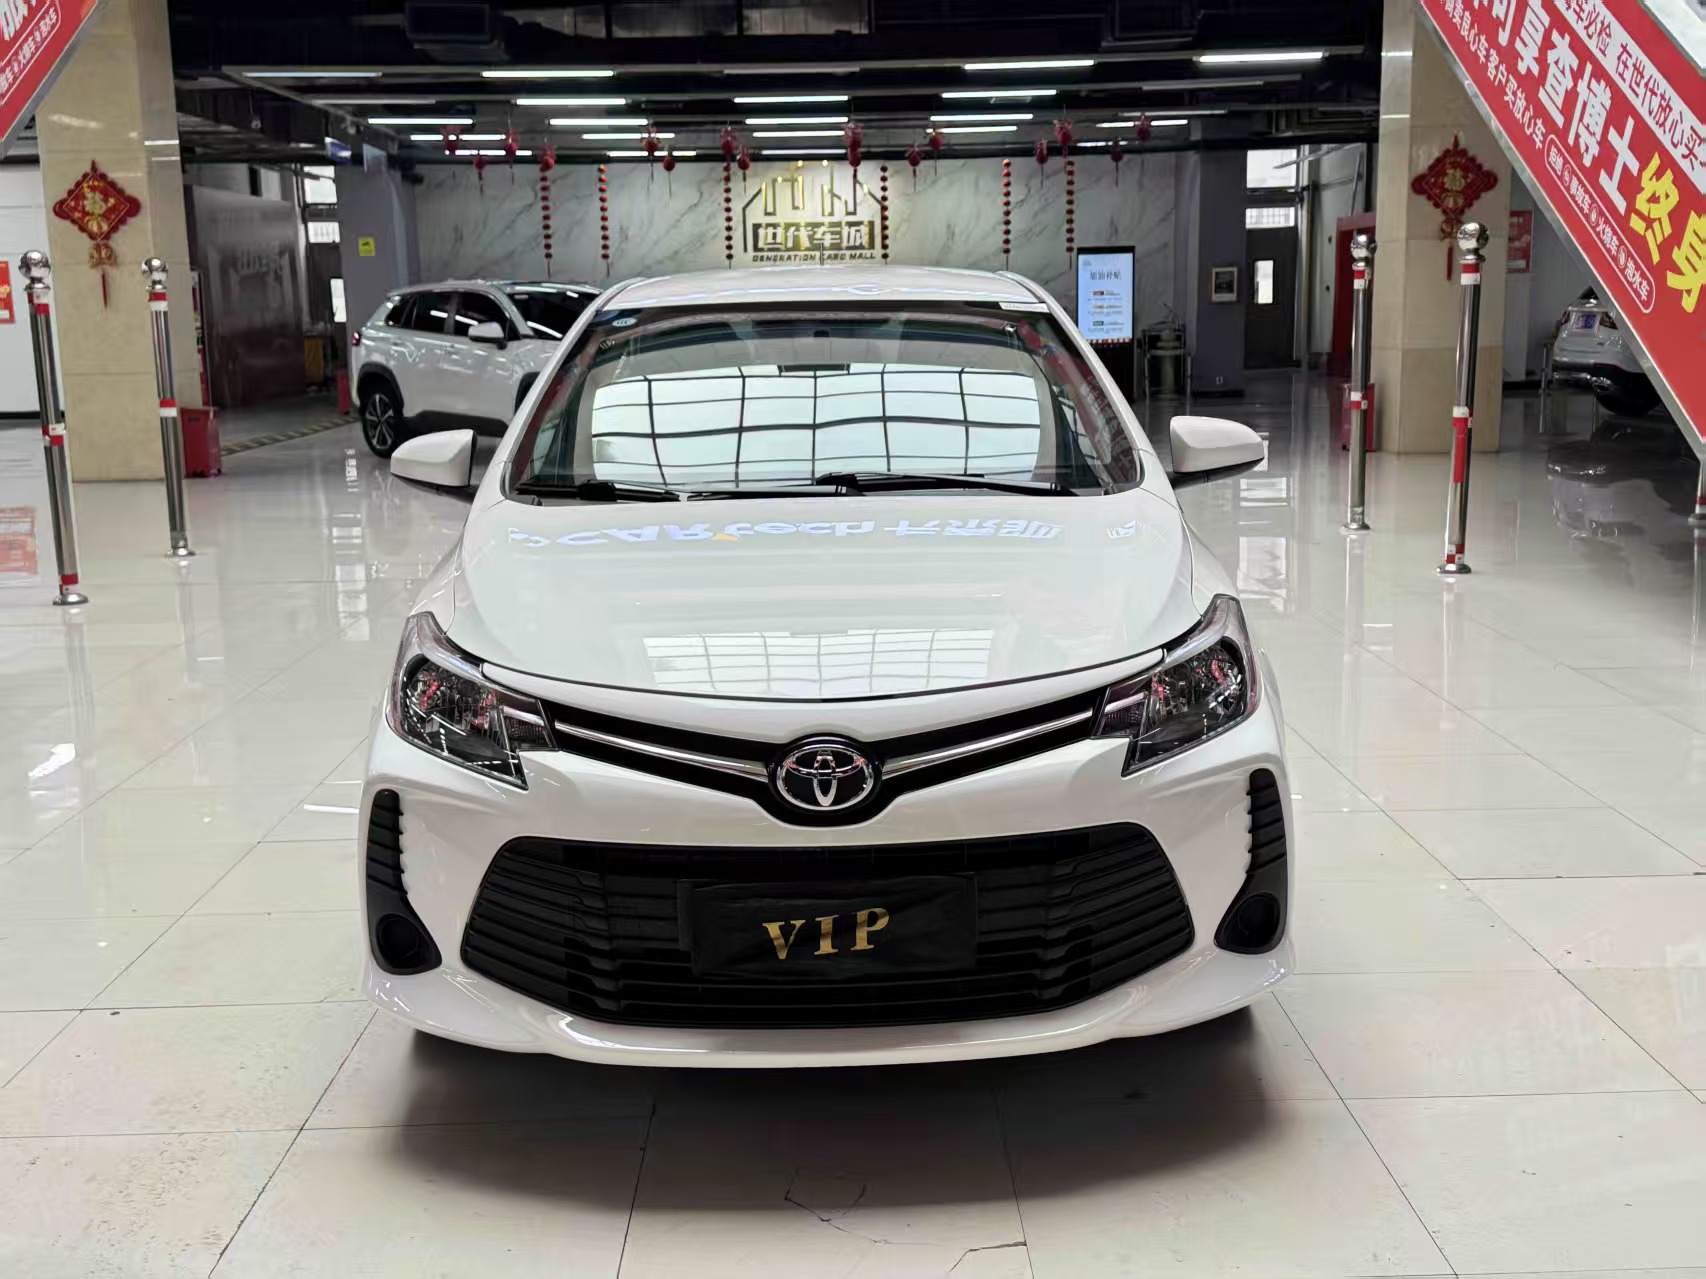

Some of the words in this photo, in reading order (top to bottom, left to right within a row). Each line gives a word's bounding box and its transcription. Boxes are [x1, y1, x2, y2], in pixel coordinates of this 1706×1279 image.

[1565, 0, 1612, 57] 车必检
[1615, 42, 1706, 171] 在世代放心买
[1474, 0, 1706, 314] 享查博士终身
[758, 225, 870, 251] 世代车城
[849, 251, 876, 261] MALL
[762, 907, 890, 960] VIP
